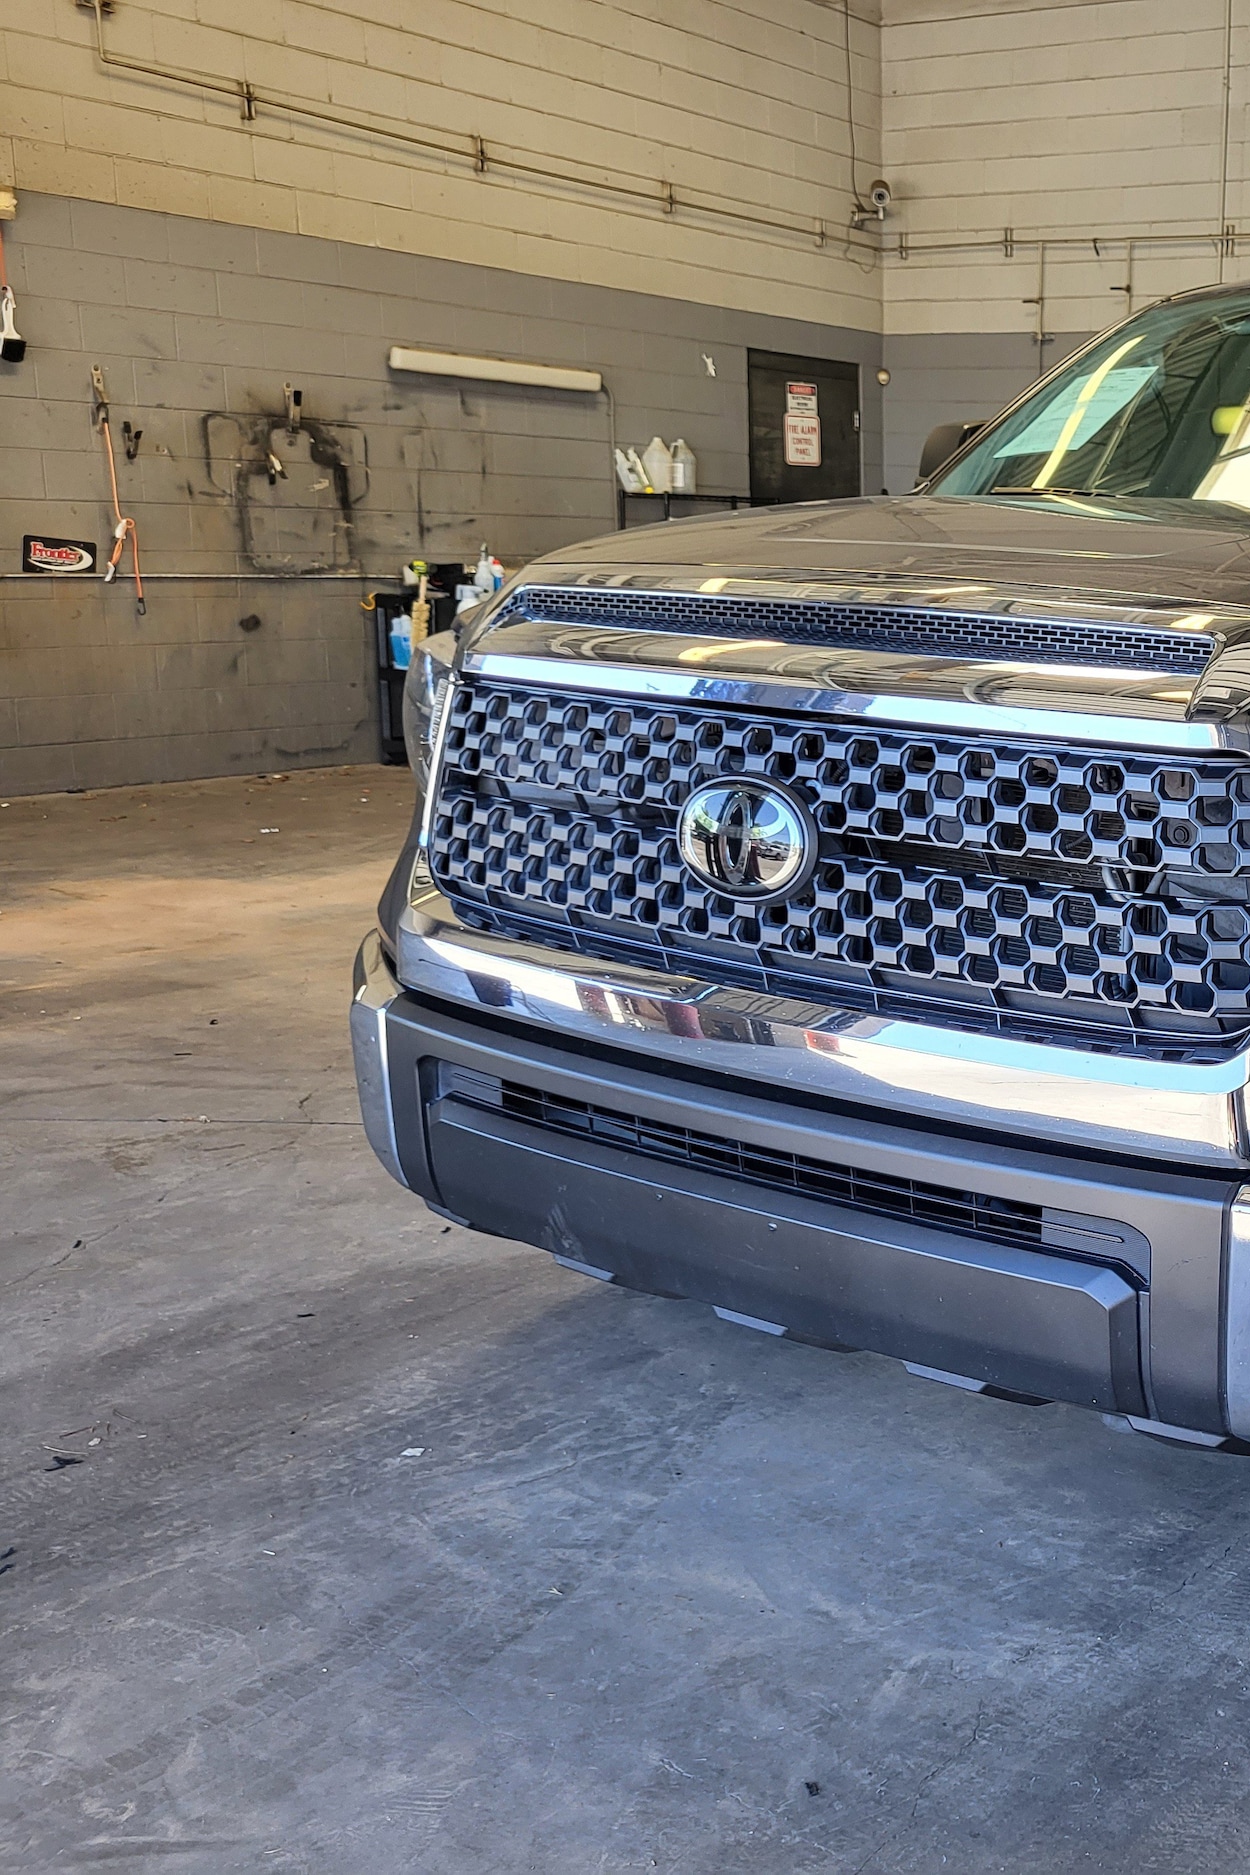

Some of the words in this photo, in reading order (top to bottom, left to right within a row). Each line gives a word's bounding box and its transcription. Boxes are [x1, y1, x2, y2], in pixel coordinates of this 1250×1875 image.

[801, 425, 817, 435] ALARM
[792, 437, 814, 446] CONTROL
[795, 448, 811, 456] PANEL
[31, 542, 80, 560] Frontier
